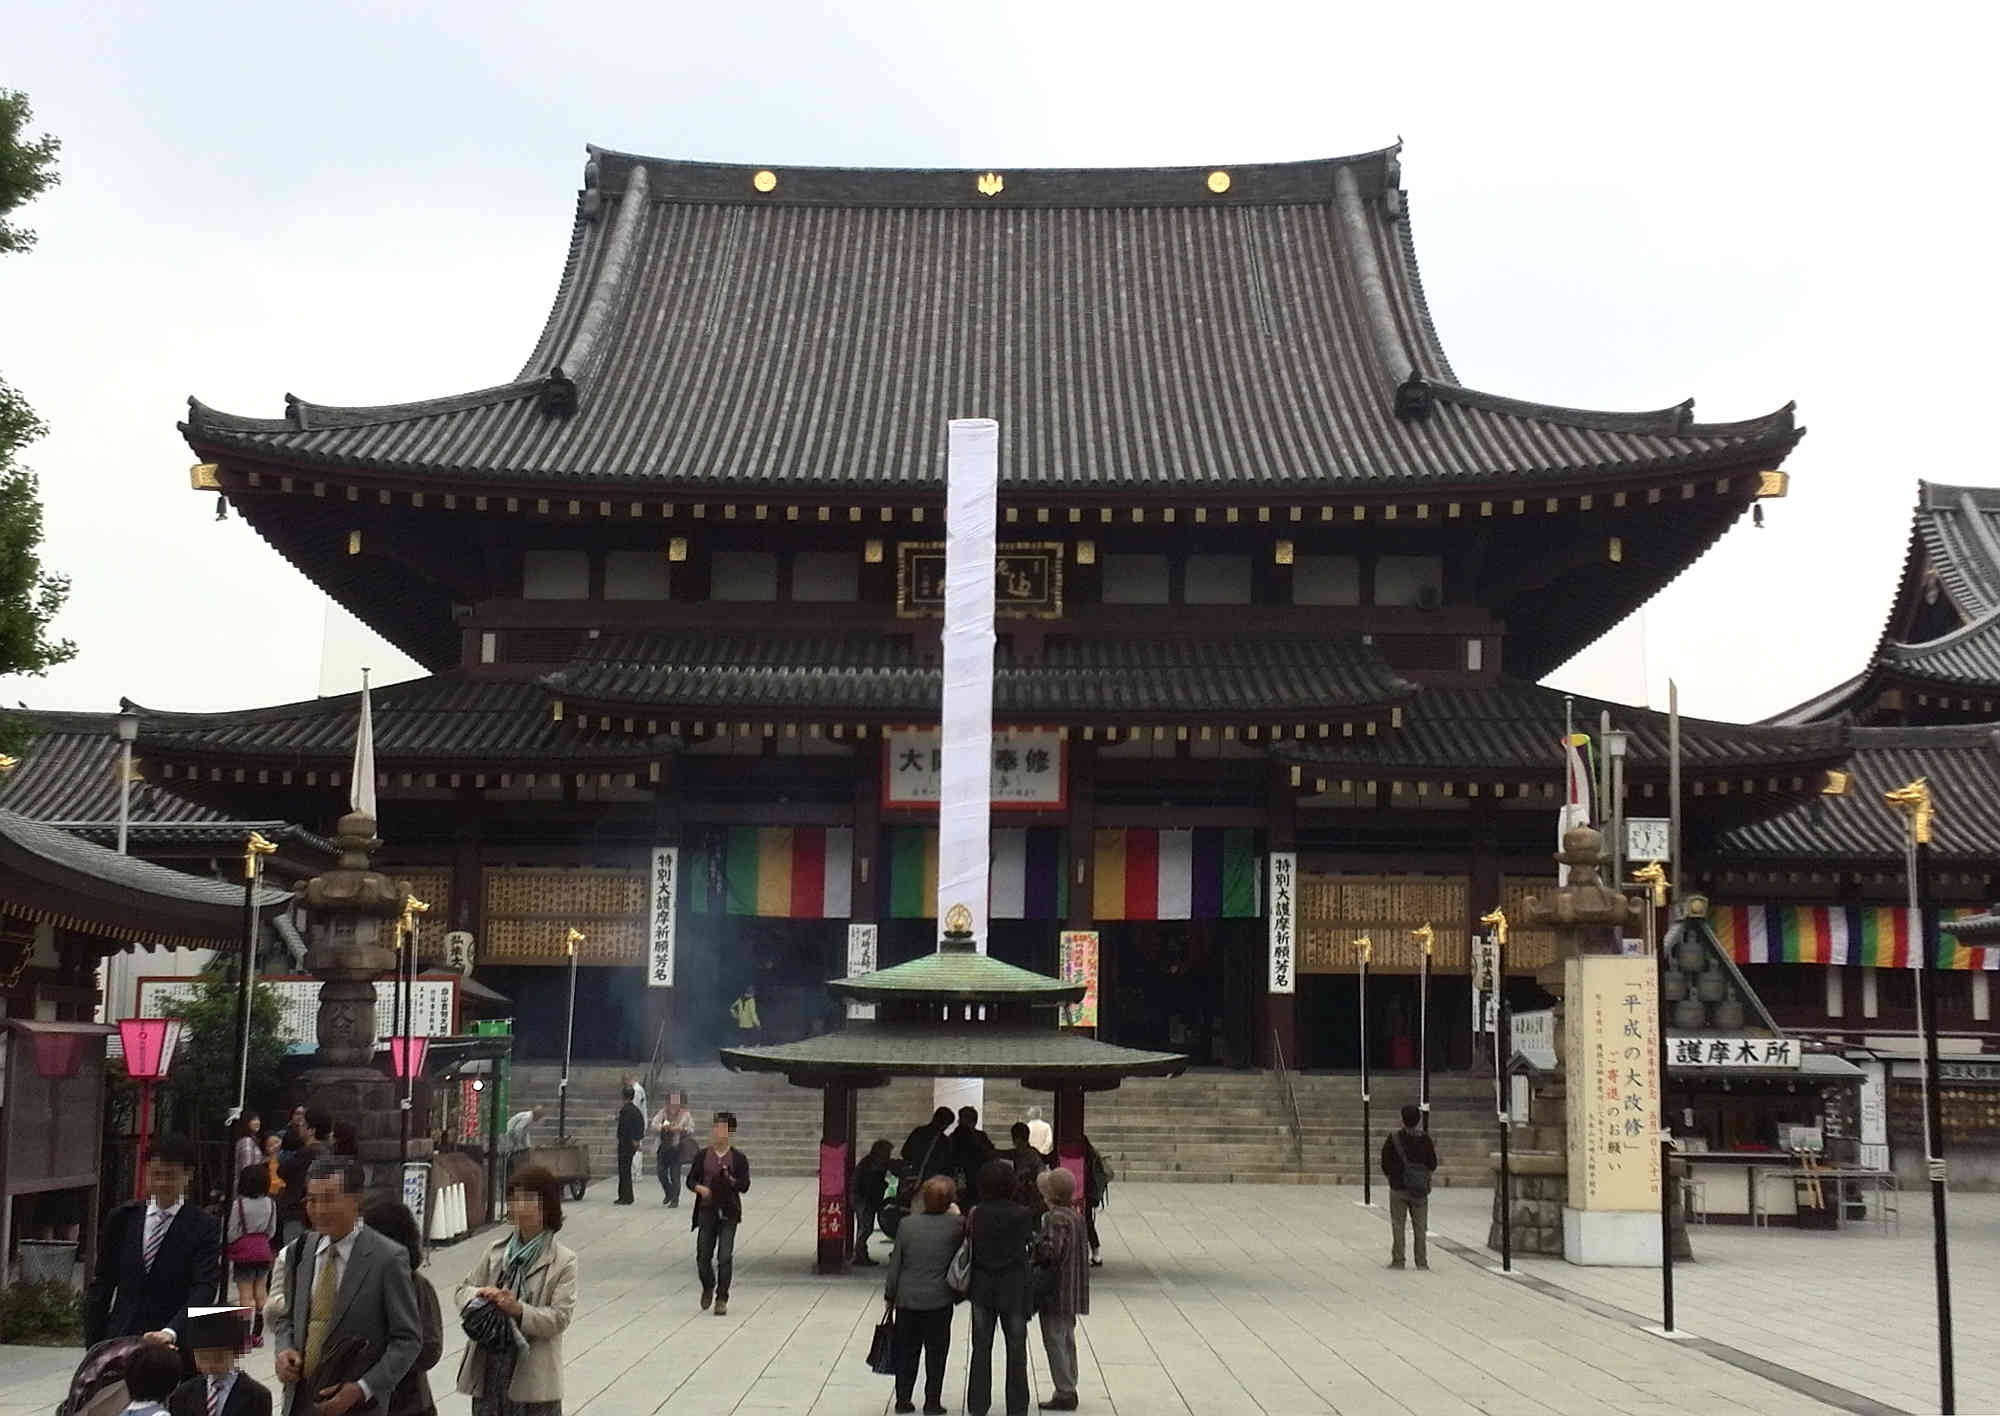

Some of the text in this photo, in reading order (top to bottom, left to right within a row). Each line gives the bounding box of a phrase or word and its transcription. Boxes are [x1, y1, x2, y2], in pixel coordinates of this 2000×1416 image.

[654, 854, 673, 982] 特別大護摩祈願芳名
[1274, 858, 1292, 987] 特別大護摩祈願芳名
[1607, 1050, 1622, 1171] ご寄進のお願い
[1621, 981, 1644, 1149] 「平成の大改修」
[1675, 1040, 1791, 1065] 護摩木所
